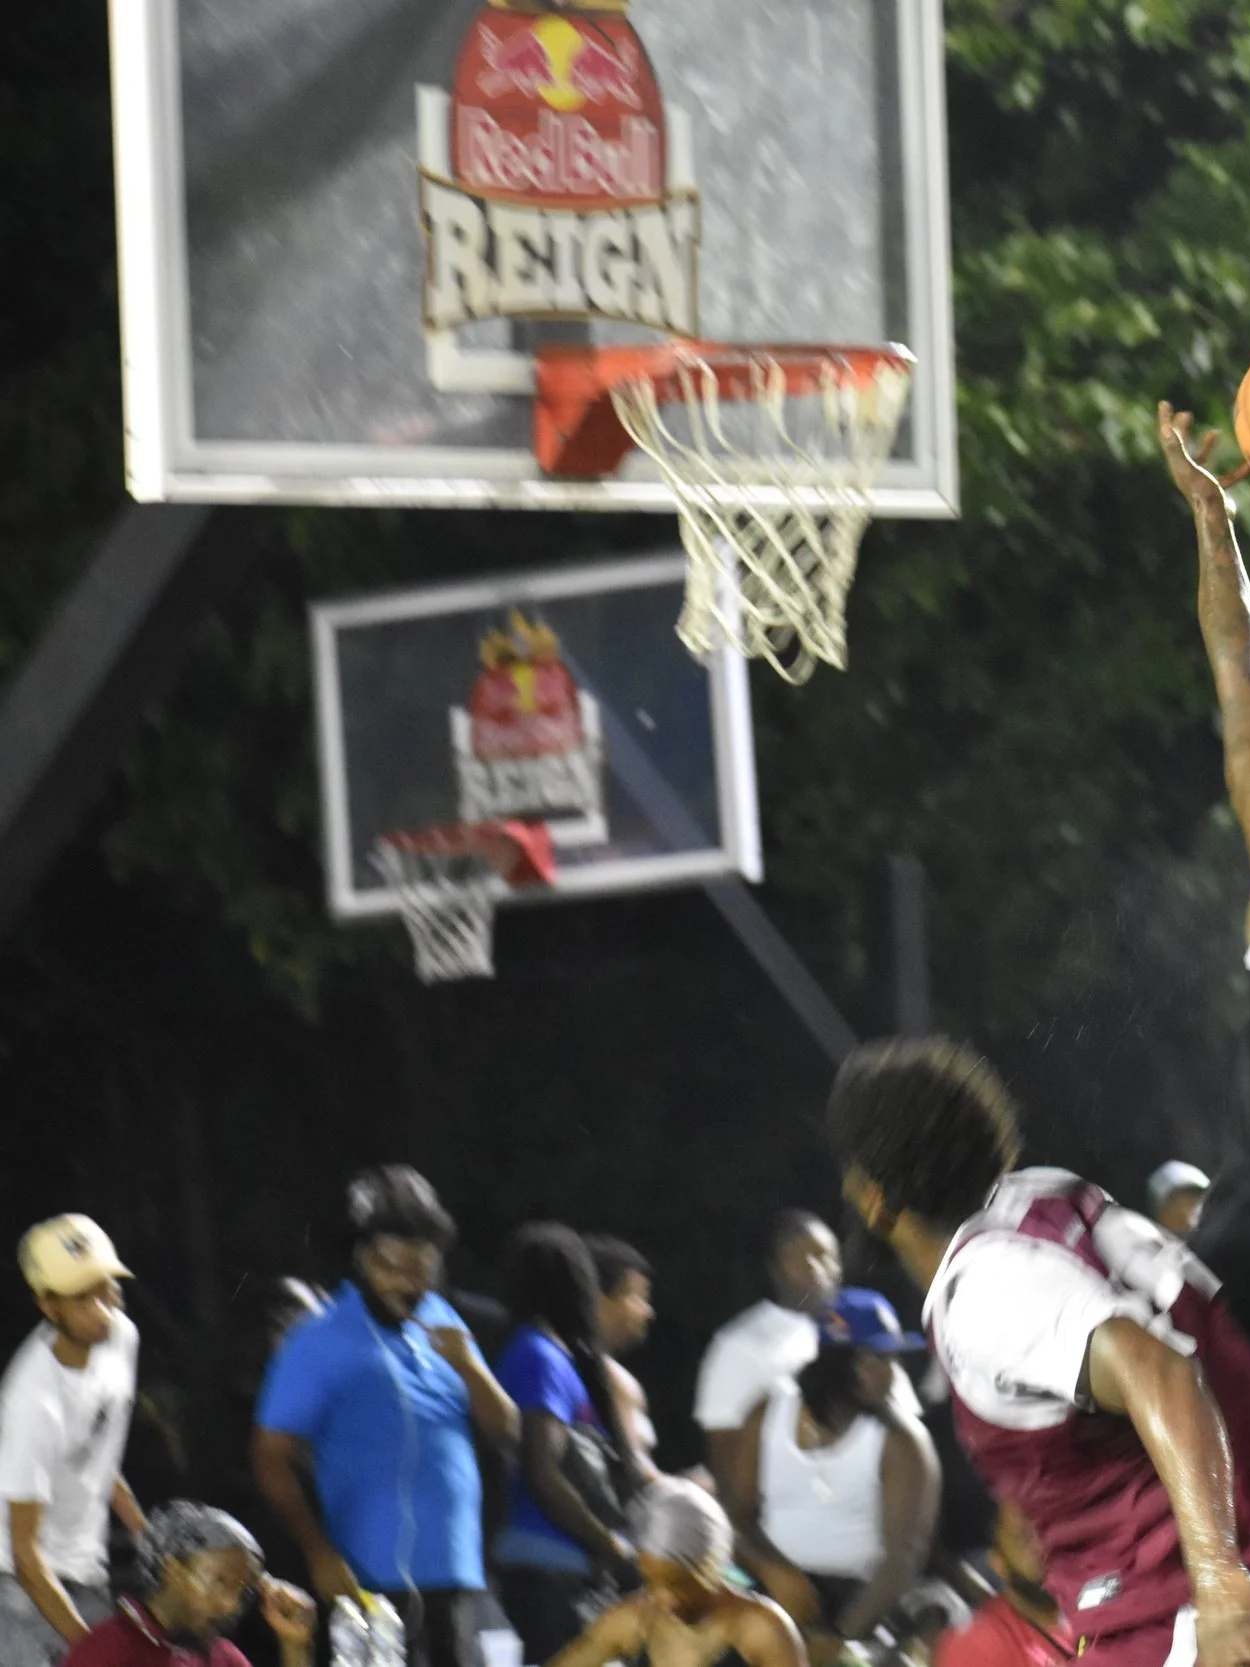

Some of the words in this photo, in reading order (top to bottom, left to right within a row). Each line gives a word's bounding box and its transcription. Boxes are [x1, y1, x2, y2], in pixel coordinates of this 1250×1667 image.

[456, 106, 564, 191] Red
[563, 112, 660, 199] Bull
[425, 182, 697, 333] REIGN
